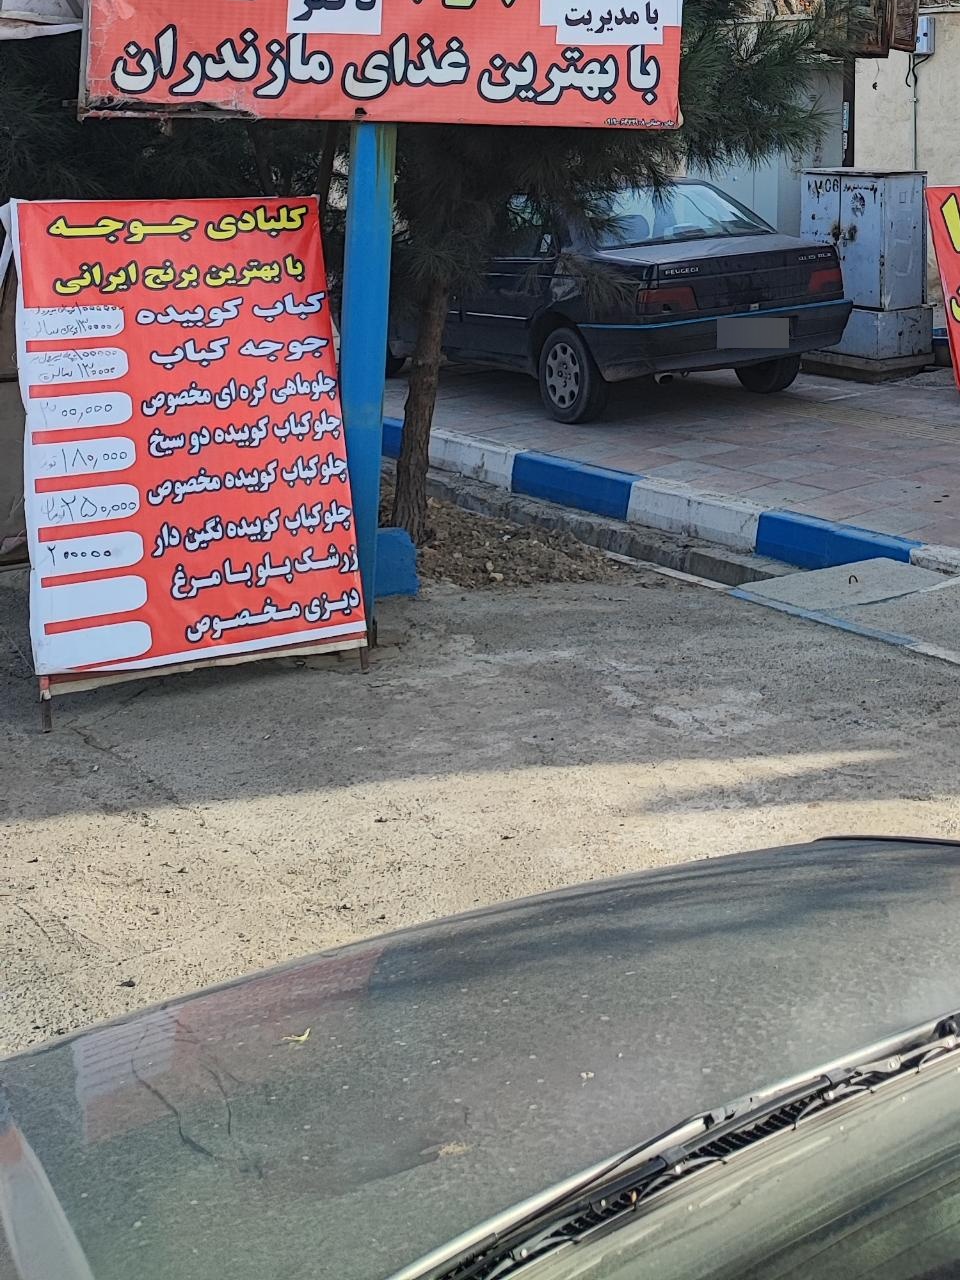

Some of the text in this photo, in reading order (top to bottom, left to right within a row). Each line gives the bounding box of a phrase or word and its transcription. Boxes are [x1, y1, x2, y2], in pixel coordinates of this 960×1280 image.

[563, 0, 659, 35] با مدیریت
[112, 23, 661, 106] با بهترین غذای مازندران
[48, 206, 308, 242] کلبادی جوجه
[55, 255, 305, 295] با بهترین برنج ایرانی
[136, 291, 326, 330] کباب کوبیده
[150, 335, 329, 367] جوجه کباب
[141, 380, 212, 417] مخصوص
[148, 427, 186, 458] سیخ
[188, 423, 211, 450] دو
[212, 417, 270, 450] کوبیده
[147, 468, 222, 507] مخصوص
[223, 461, 279, 494] کوبیده
[152, 523, 181, 559] دار
[183, 519, 225, 551] نگین
[226, 507, 281, 540] کوبیده
[171, 545, 360, 600] زرشک پلو با مرغ
[185, 587, 361, 642] دیزی مخصوص
